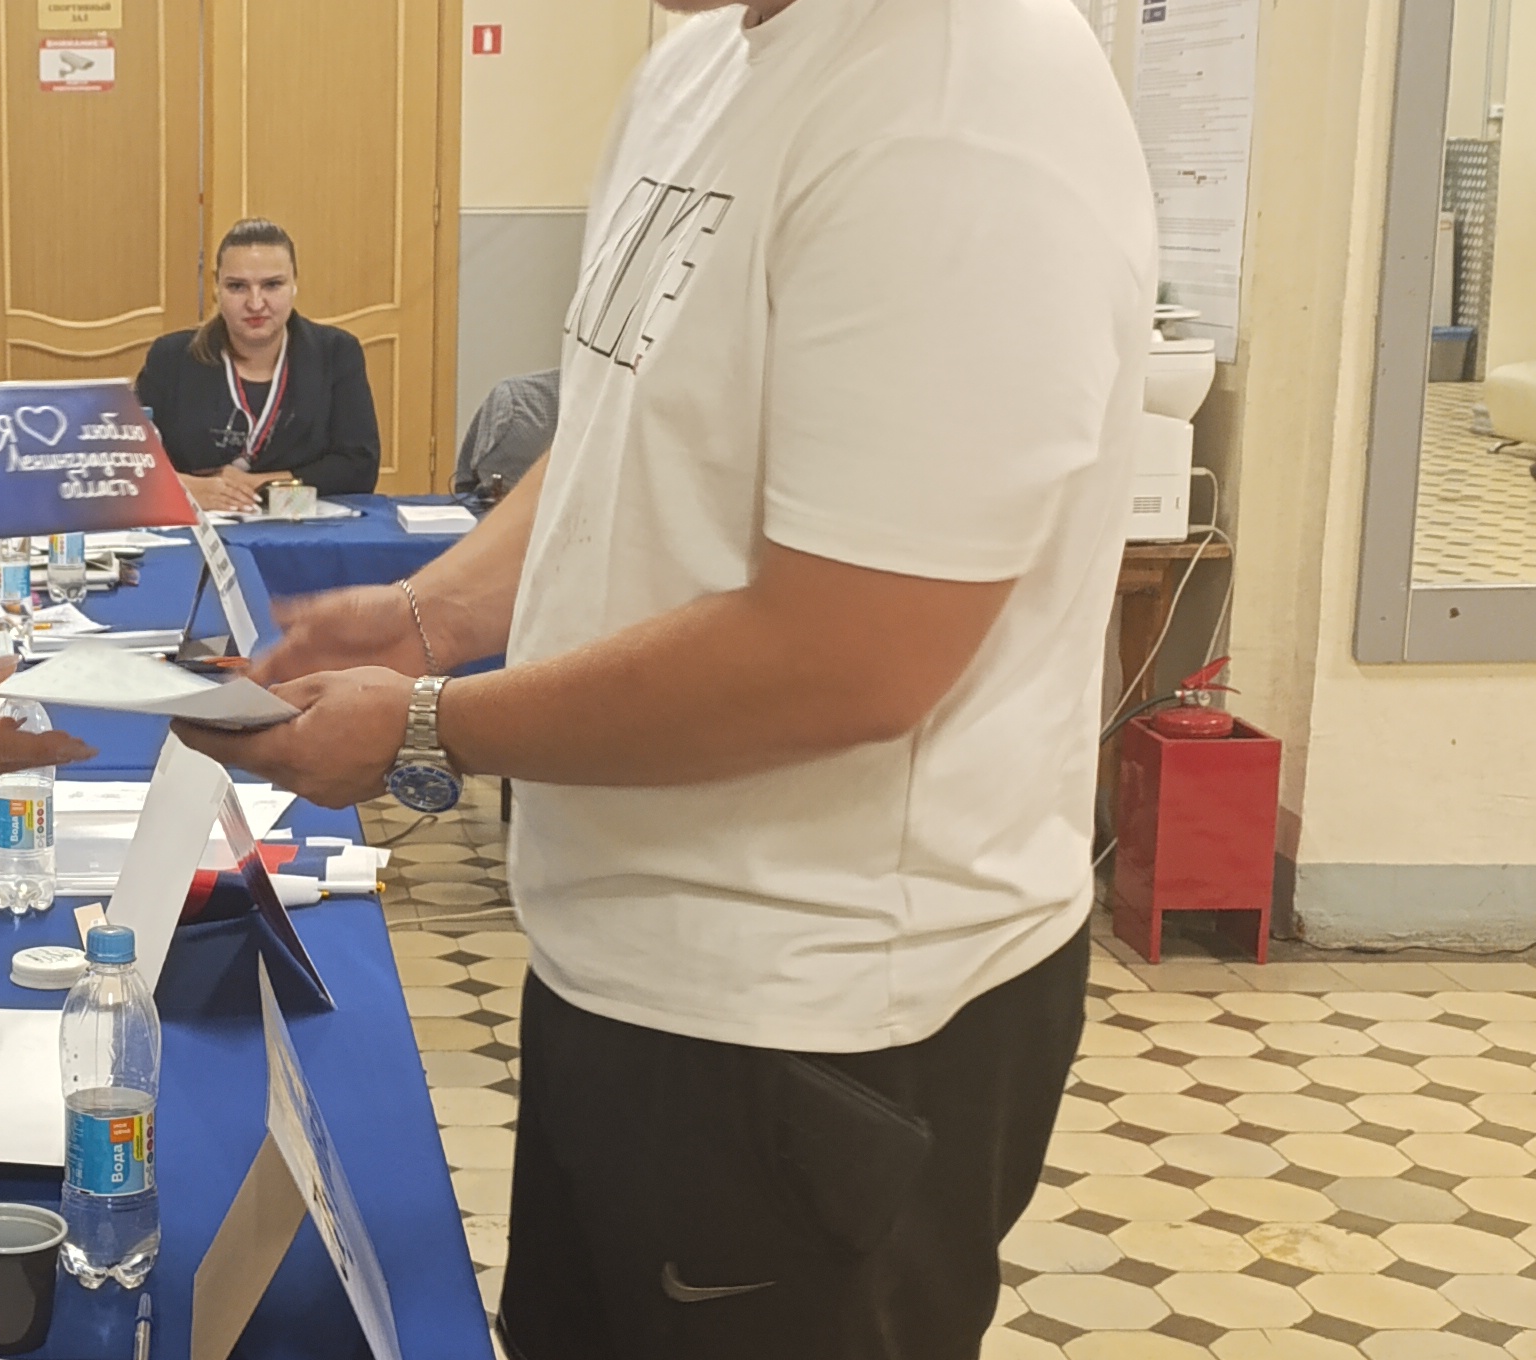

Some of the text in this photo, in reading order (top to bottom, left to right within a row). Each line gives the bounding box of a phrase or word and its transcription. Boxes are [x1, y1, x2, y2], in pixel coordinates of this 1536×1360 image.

[77, 412, 147, 441] люблю
[5, 443, 156, 478] Ленинградскую
[59, 468, 139, 500] область
[10, 816, 19, 842] Вода
[111, 1143, 125, 1183] Вода
